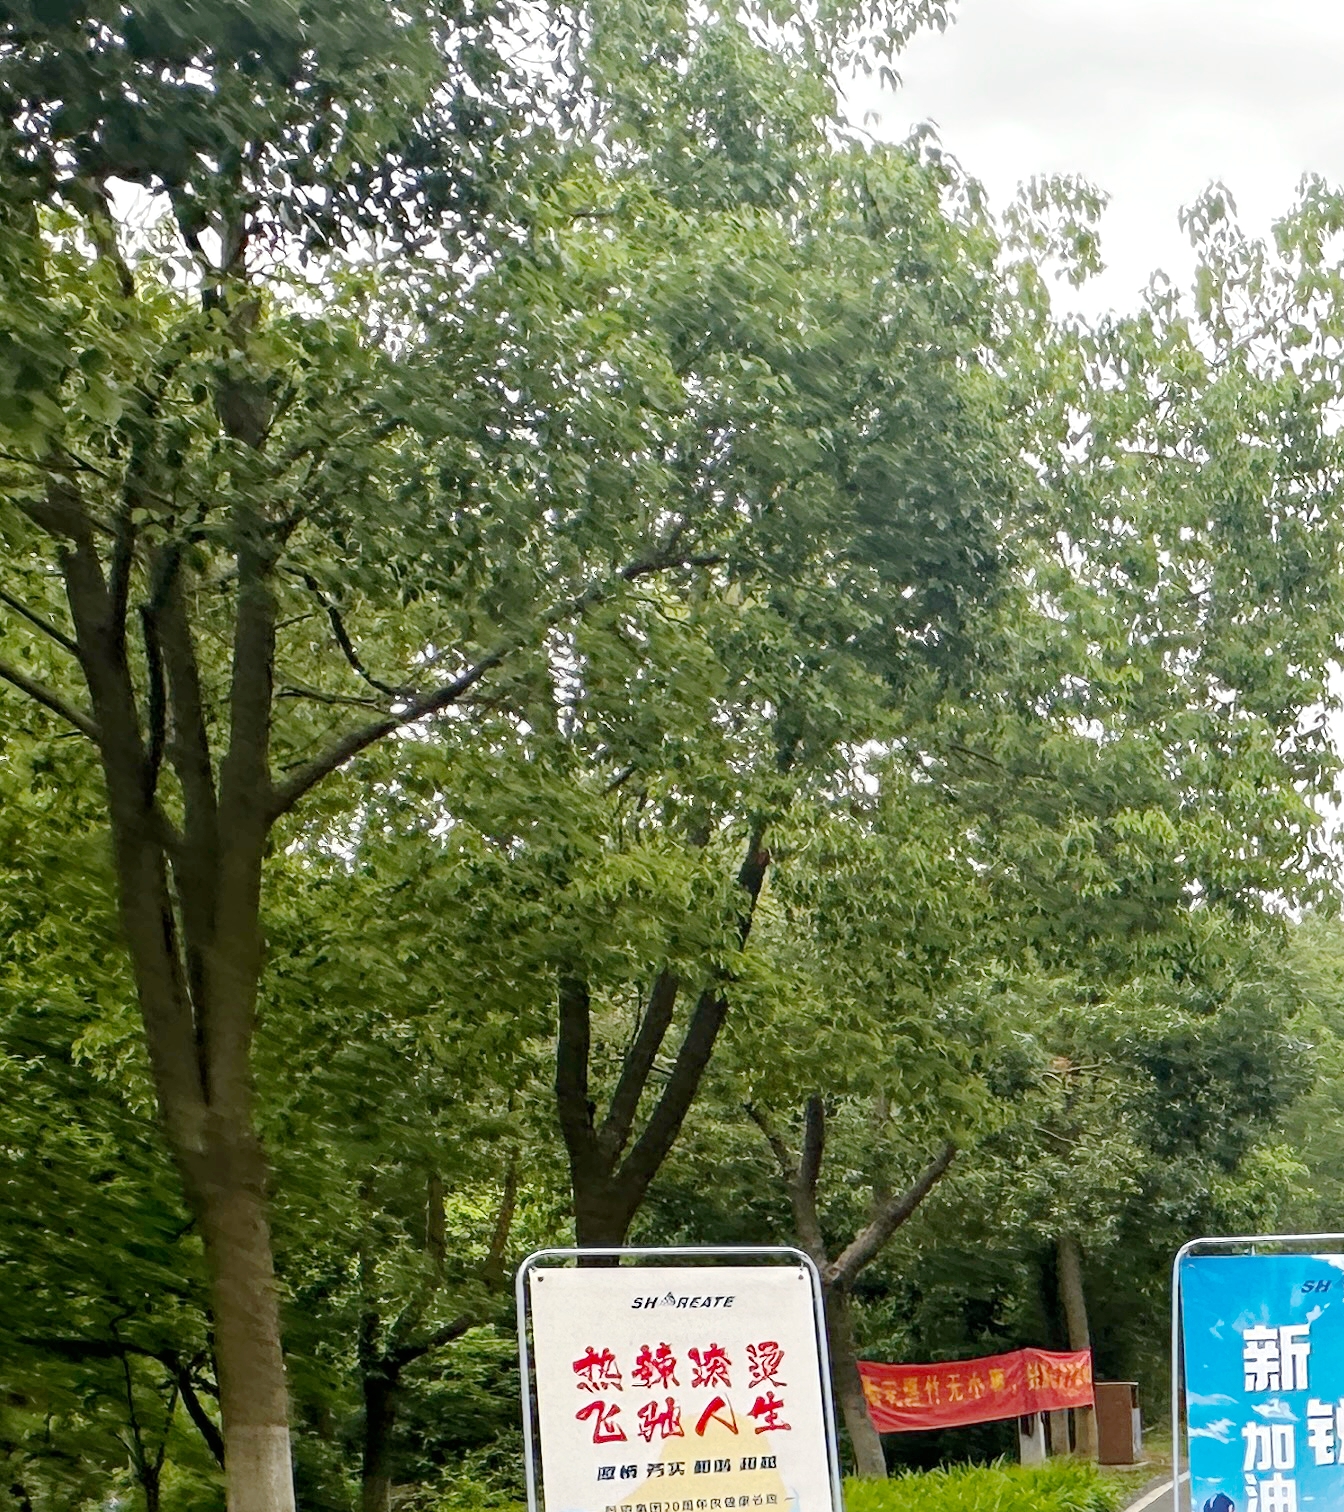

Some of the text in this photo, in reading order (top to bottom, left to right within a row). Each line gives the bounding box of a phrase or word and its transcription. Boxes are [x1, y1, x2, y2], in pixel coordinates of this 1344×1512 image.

[572, 1340, 789, 1393] 热辣滚烫
[575, 1391, 792, 1445] 飞驰人生
